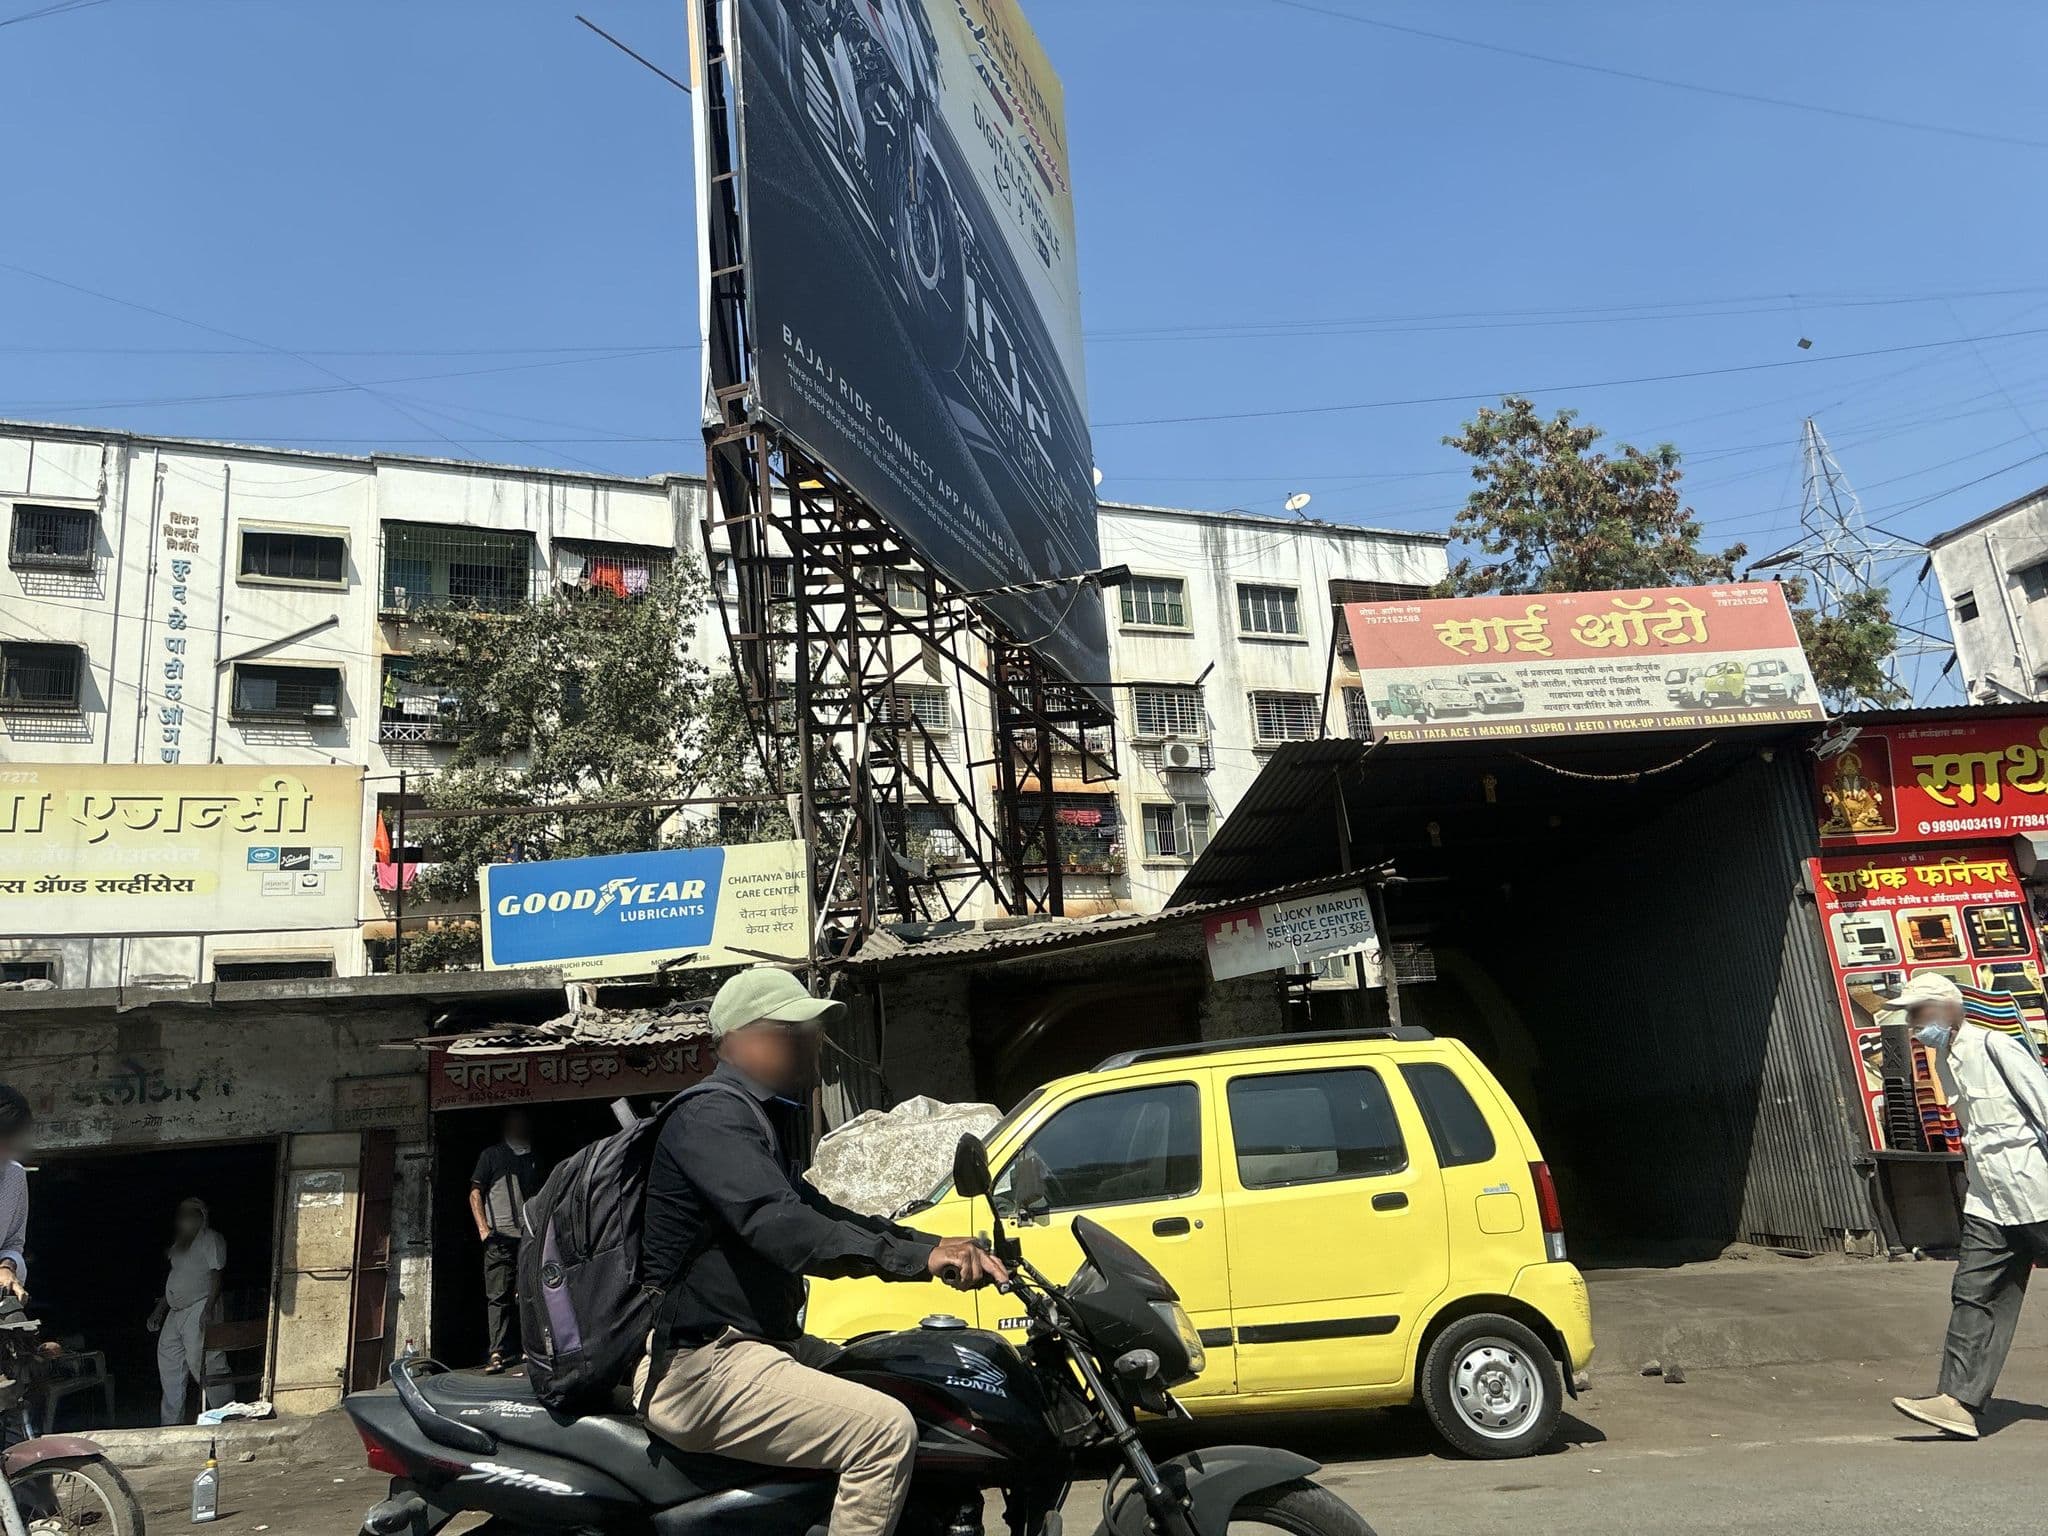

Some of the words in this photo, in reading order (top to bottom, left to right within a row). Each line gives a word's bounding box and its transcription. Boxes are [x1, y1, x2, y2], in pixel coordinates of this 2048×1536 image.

[973, 102, 1017, 189] DIGITAL
[1017, 175, 1061, 262] CONSOLE
[788, 373, 803, 395] The
[804, 390, 825, 415] speed
[826, 409, 856, 444] displayed
[814, 380, 834, 406] follow
[847, 414, 866, 436] speed
[782, 323, 834, 384] BAJAJ
[839, 377, 873, 422] RIDE
[877, 416, 934, 483] CONNECT
[938, 479, 959, 506] APP
[963, 502, 1015, 563] AVAILABLE
[1432, 603, 1554, 657] साई
[1570, 596, 1710, 649] ऑटो
[1423, 729, 1447, 740] TATA
[1450, 727, 1470, 738] ACE
[1480, 725, 1522, 737] MAXIMO
[1531, 721, 1566, 733] SUPRO
[1574, 720, 1605, 731] JEETO
[1614, 717, 1655, 729] PICK-UP
[1664, 715, 1696, 727] CARRY
[1704, 713, 1735, 725] BAJAJ
[1738, 711, 1779, 723] MAXIMA
[1787, 709, 1813, 720] DOST
[1932, 817, 2002, 834] 9890403419
[728, 873, 782, 885] CHAITANYA
[785, 870, 806, 880] BIKE
[736, 889, 760, 899] CARE
[763, 885, 800, 897] CENTER
[1821, 861, 1907, 893] सार्थक
[620, 904, 706, 923] LUBRICANTS
[1266, 918, 1317, 939] SERVICE
[1320, 910, 1367, 928] CENTRE
[1273, 906, 1314, 924] LUCKY
[1317, 897, 1364, 918] MARUTI
[945, 1375, 1008, 1398] HONDA
